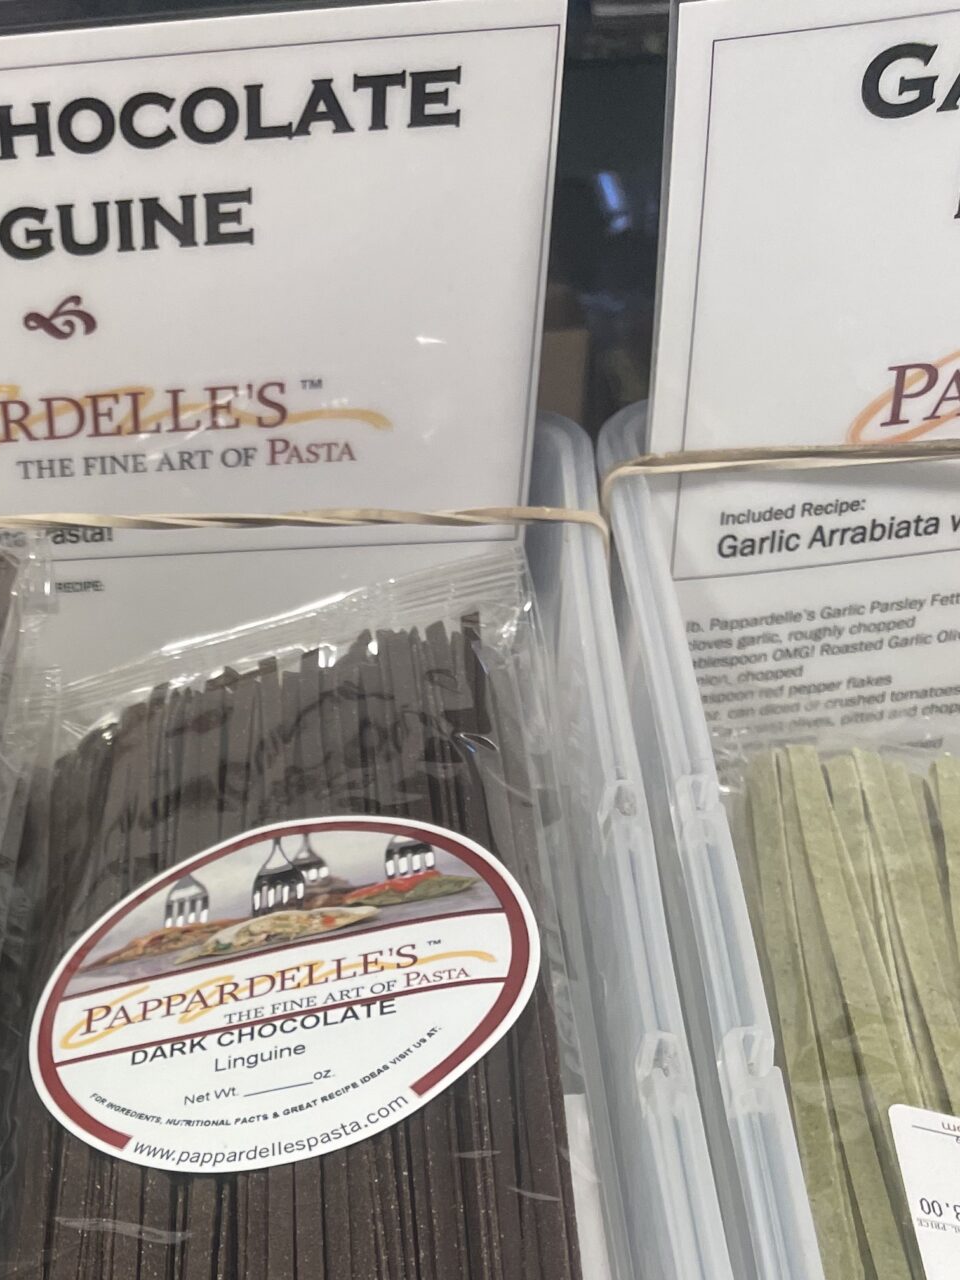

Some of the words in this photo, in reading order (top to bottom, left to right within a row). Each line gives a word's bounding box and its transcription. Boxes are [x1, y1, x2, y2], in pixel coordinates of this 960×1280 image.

[16, 457, 75, 481] THE
[83, 453, 148, 477] FINE
[156, 449, 212, 472] ART
[219, 446, 258, 467] OF
[266, 438, 358, 467] PASTA
[720, 504, 796, 526] Included
[801, 499, 866, 519] Recipe:
[46, 527, 113, 545] asta!
[717, 529, 801, 559] Garlic
[808, 514, 940, 549] Arrabiata
[709, 609, 816, 632] Pappardelle's
[820, 605, 866, 619] Garlic
[870, 597, 927, 614] Parsley
[848, 616, 916, 635] chopped
[888, 633, 933, 650] Garlic
[79, 943, 419, 1037] PAPPARDELLE'S
[224, 1007, 267, 1025] THE
[270, 997, 319, 1016] FINE
[322, 986, 365, 1006] ART
[370, 980, 397, 995] OF
[403, 965, 470, 988] PASTA
[131, 1033, 209, 1066] DARK
[216, 998, 397, 1048] CHOCOLATE
[214, 1043, 307, 1072] Linguine
[89, 1092, 107, 1106] FOR
[234, 1113, 269, 1125] FACTS
[272, 1111, 280, 1119] &
[282, 1099, 319, 1116] GREAT
[320, 1081, 360, 1103] RECIPE
[360, 1064, 390, 1085] IDEAS
[389, 1047, 414, 1066] VISIT
[183, 1092, 211, 1105] Net
[133, 1095, 409, 1167] www.pappardellespasta.com
